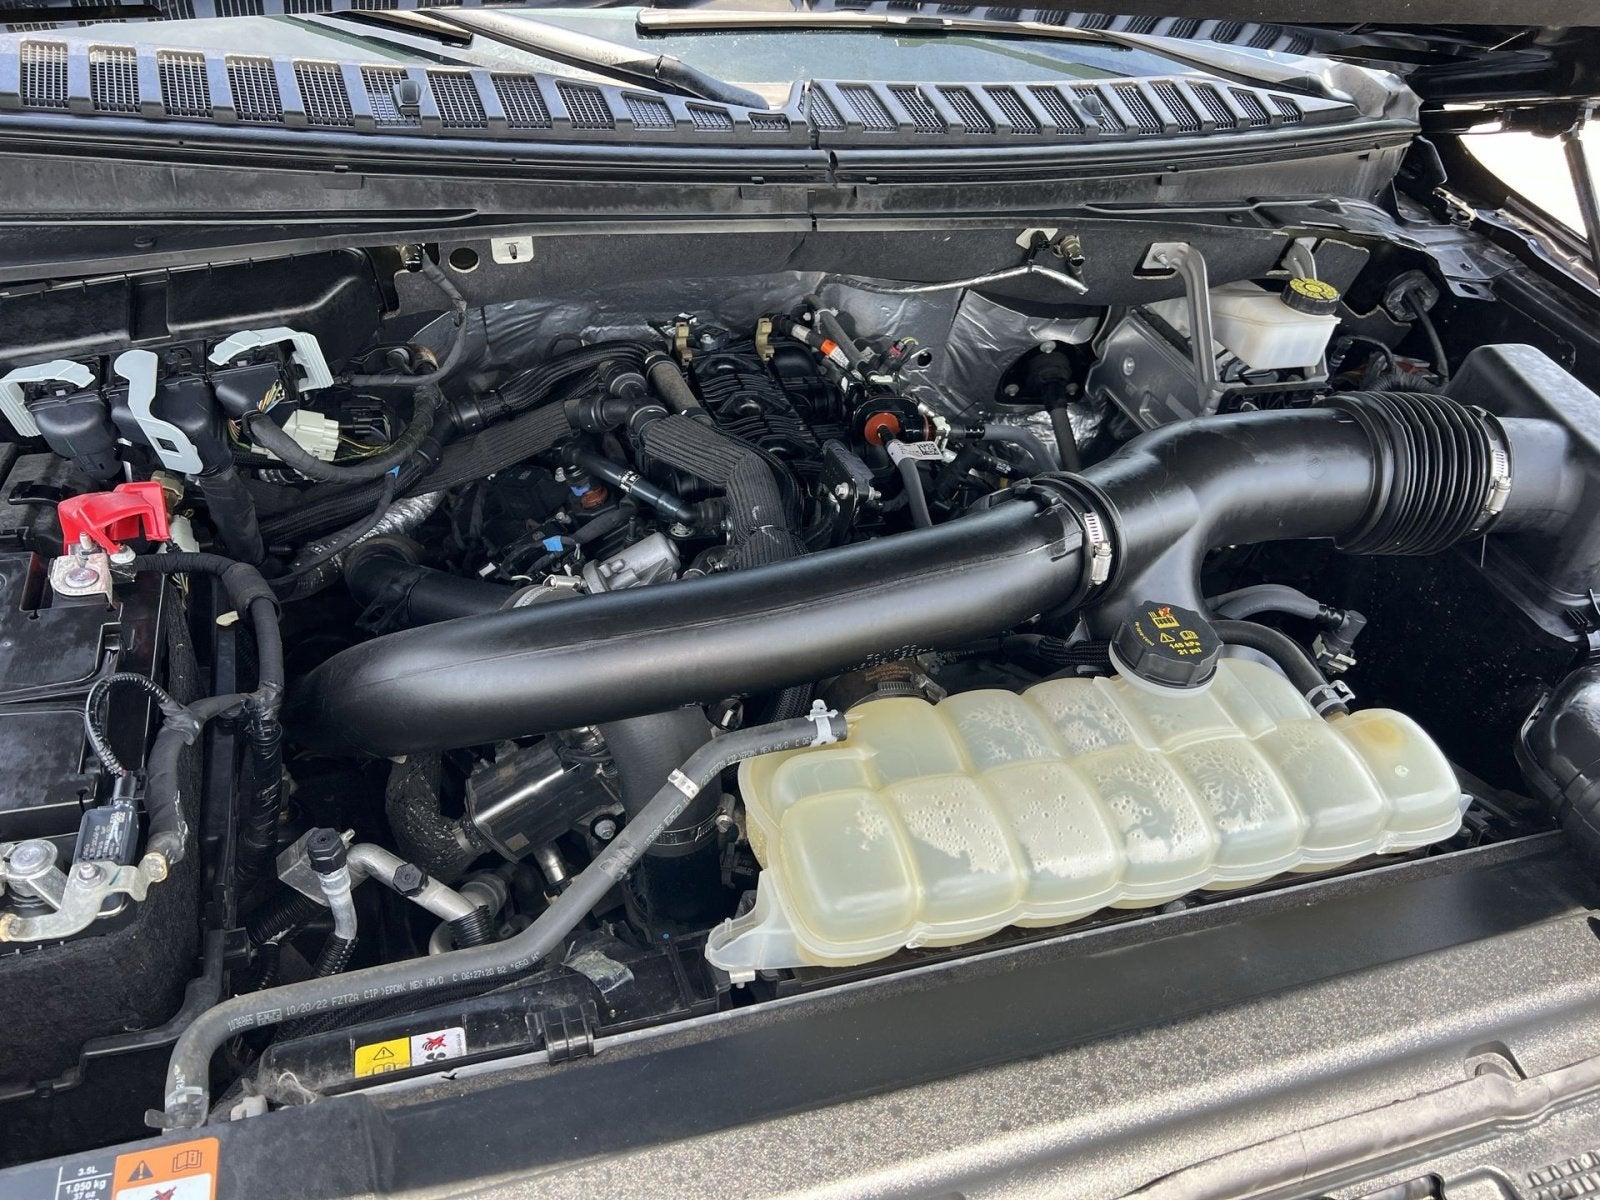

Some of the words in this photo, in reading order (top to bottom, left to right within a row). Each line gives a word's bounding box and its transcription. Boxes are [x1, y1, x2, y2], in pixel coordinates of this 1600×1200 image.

[1190, 647, 1202, 655] psi
[286, 999, 328, 1017] 10/20/22
[409, 977, 424, 991] MEX
[452, 974, 459, 982] C
[77, 1166, 98, 1176] 3.5L
[65, 1181, 91, 1194] 1.050
[93, 1179, 107, 1190] kg
[85, 1191, 96, 1199] oz
